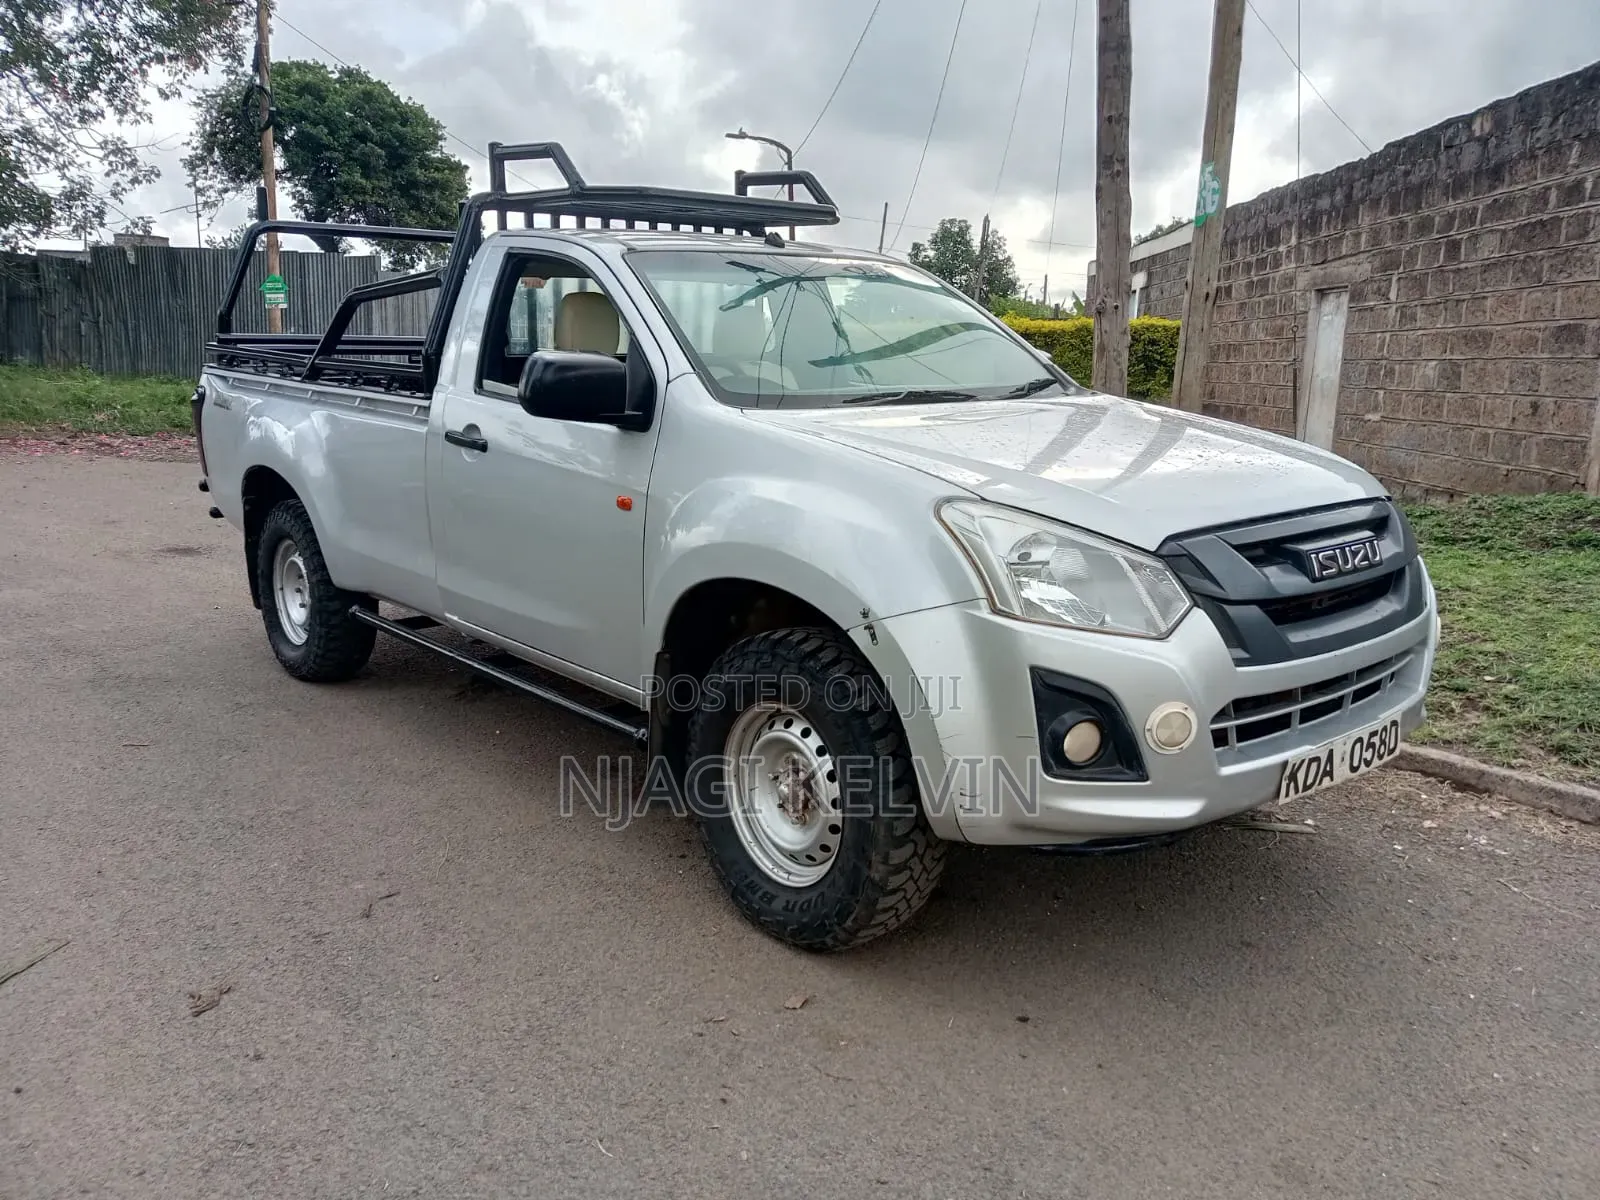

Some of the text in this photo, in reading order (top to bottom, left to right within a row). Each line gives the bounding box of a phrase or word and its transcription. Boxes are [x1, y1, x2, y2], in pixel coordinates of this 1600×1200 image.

[1311, 541, 1380, 578] ISUZU
[1284, 720, 1399, 798] KDA 058D
